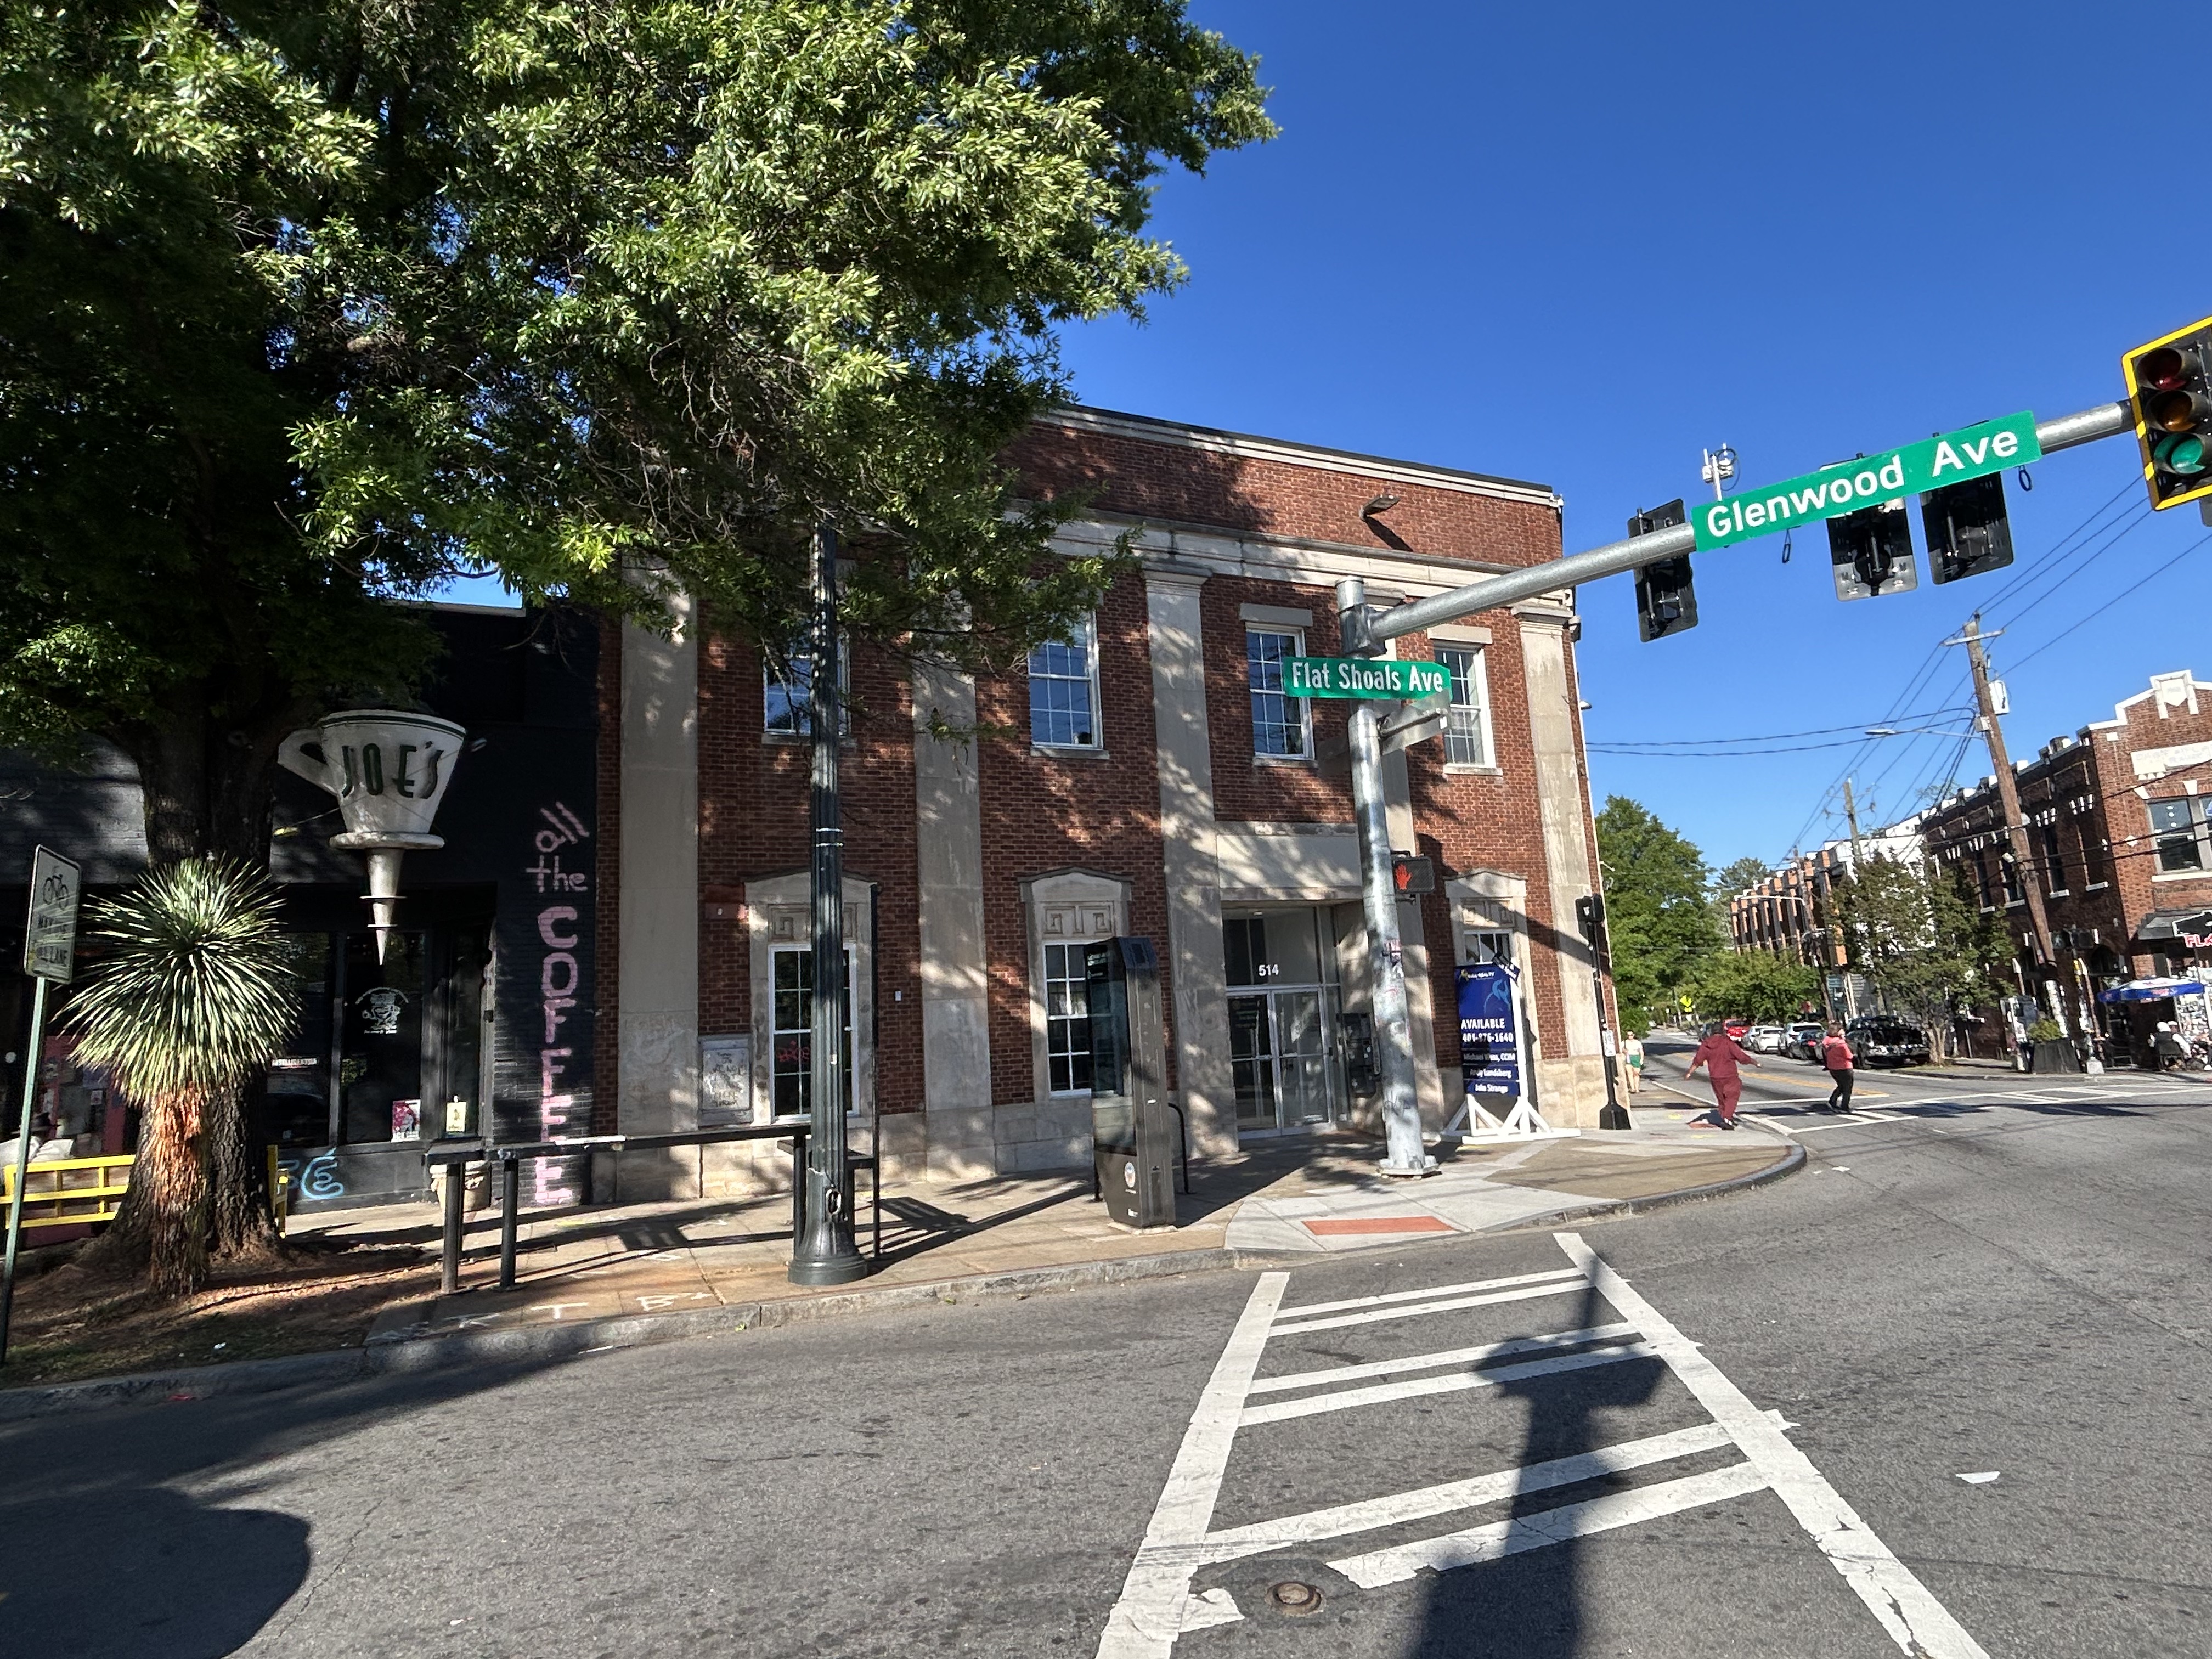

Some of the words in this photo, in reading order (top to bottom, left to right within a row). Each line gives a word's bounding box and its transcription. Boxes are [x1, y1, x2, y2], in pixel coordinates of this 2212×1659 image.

[1707, 454, 1905, 537] Glenwood
[1932, 430, 2018, 477] Ave
[1292, 662, 1330, 689] Flat
[1339, 663, 1401, 691] Shoals
[1409, 665, 1443, 692] Ave
[341, 741, 444, 799] JOE'S
[536, 801, 590, 852] all
[526, 855, 588, 893] the
[1259, 964, 1279, 977] 514
[1461, 1018, 1505, 1029] AVAILABLE
[535, 906, 578, 1204] COFFEE
